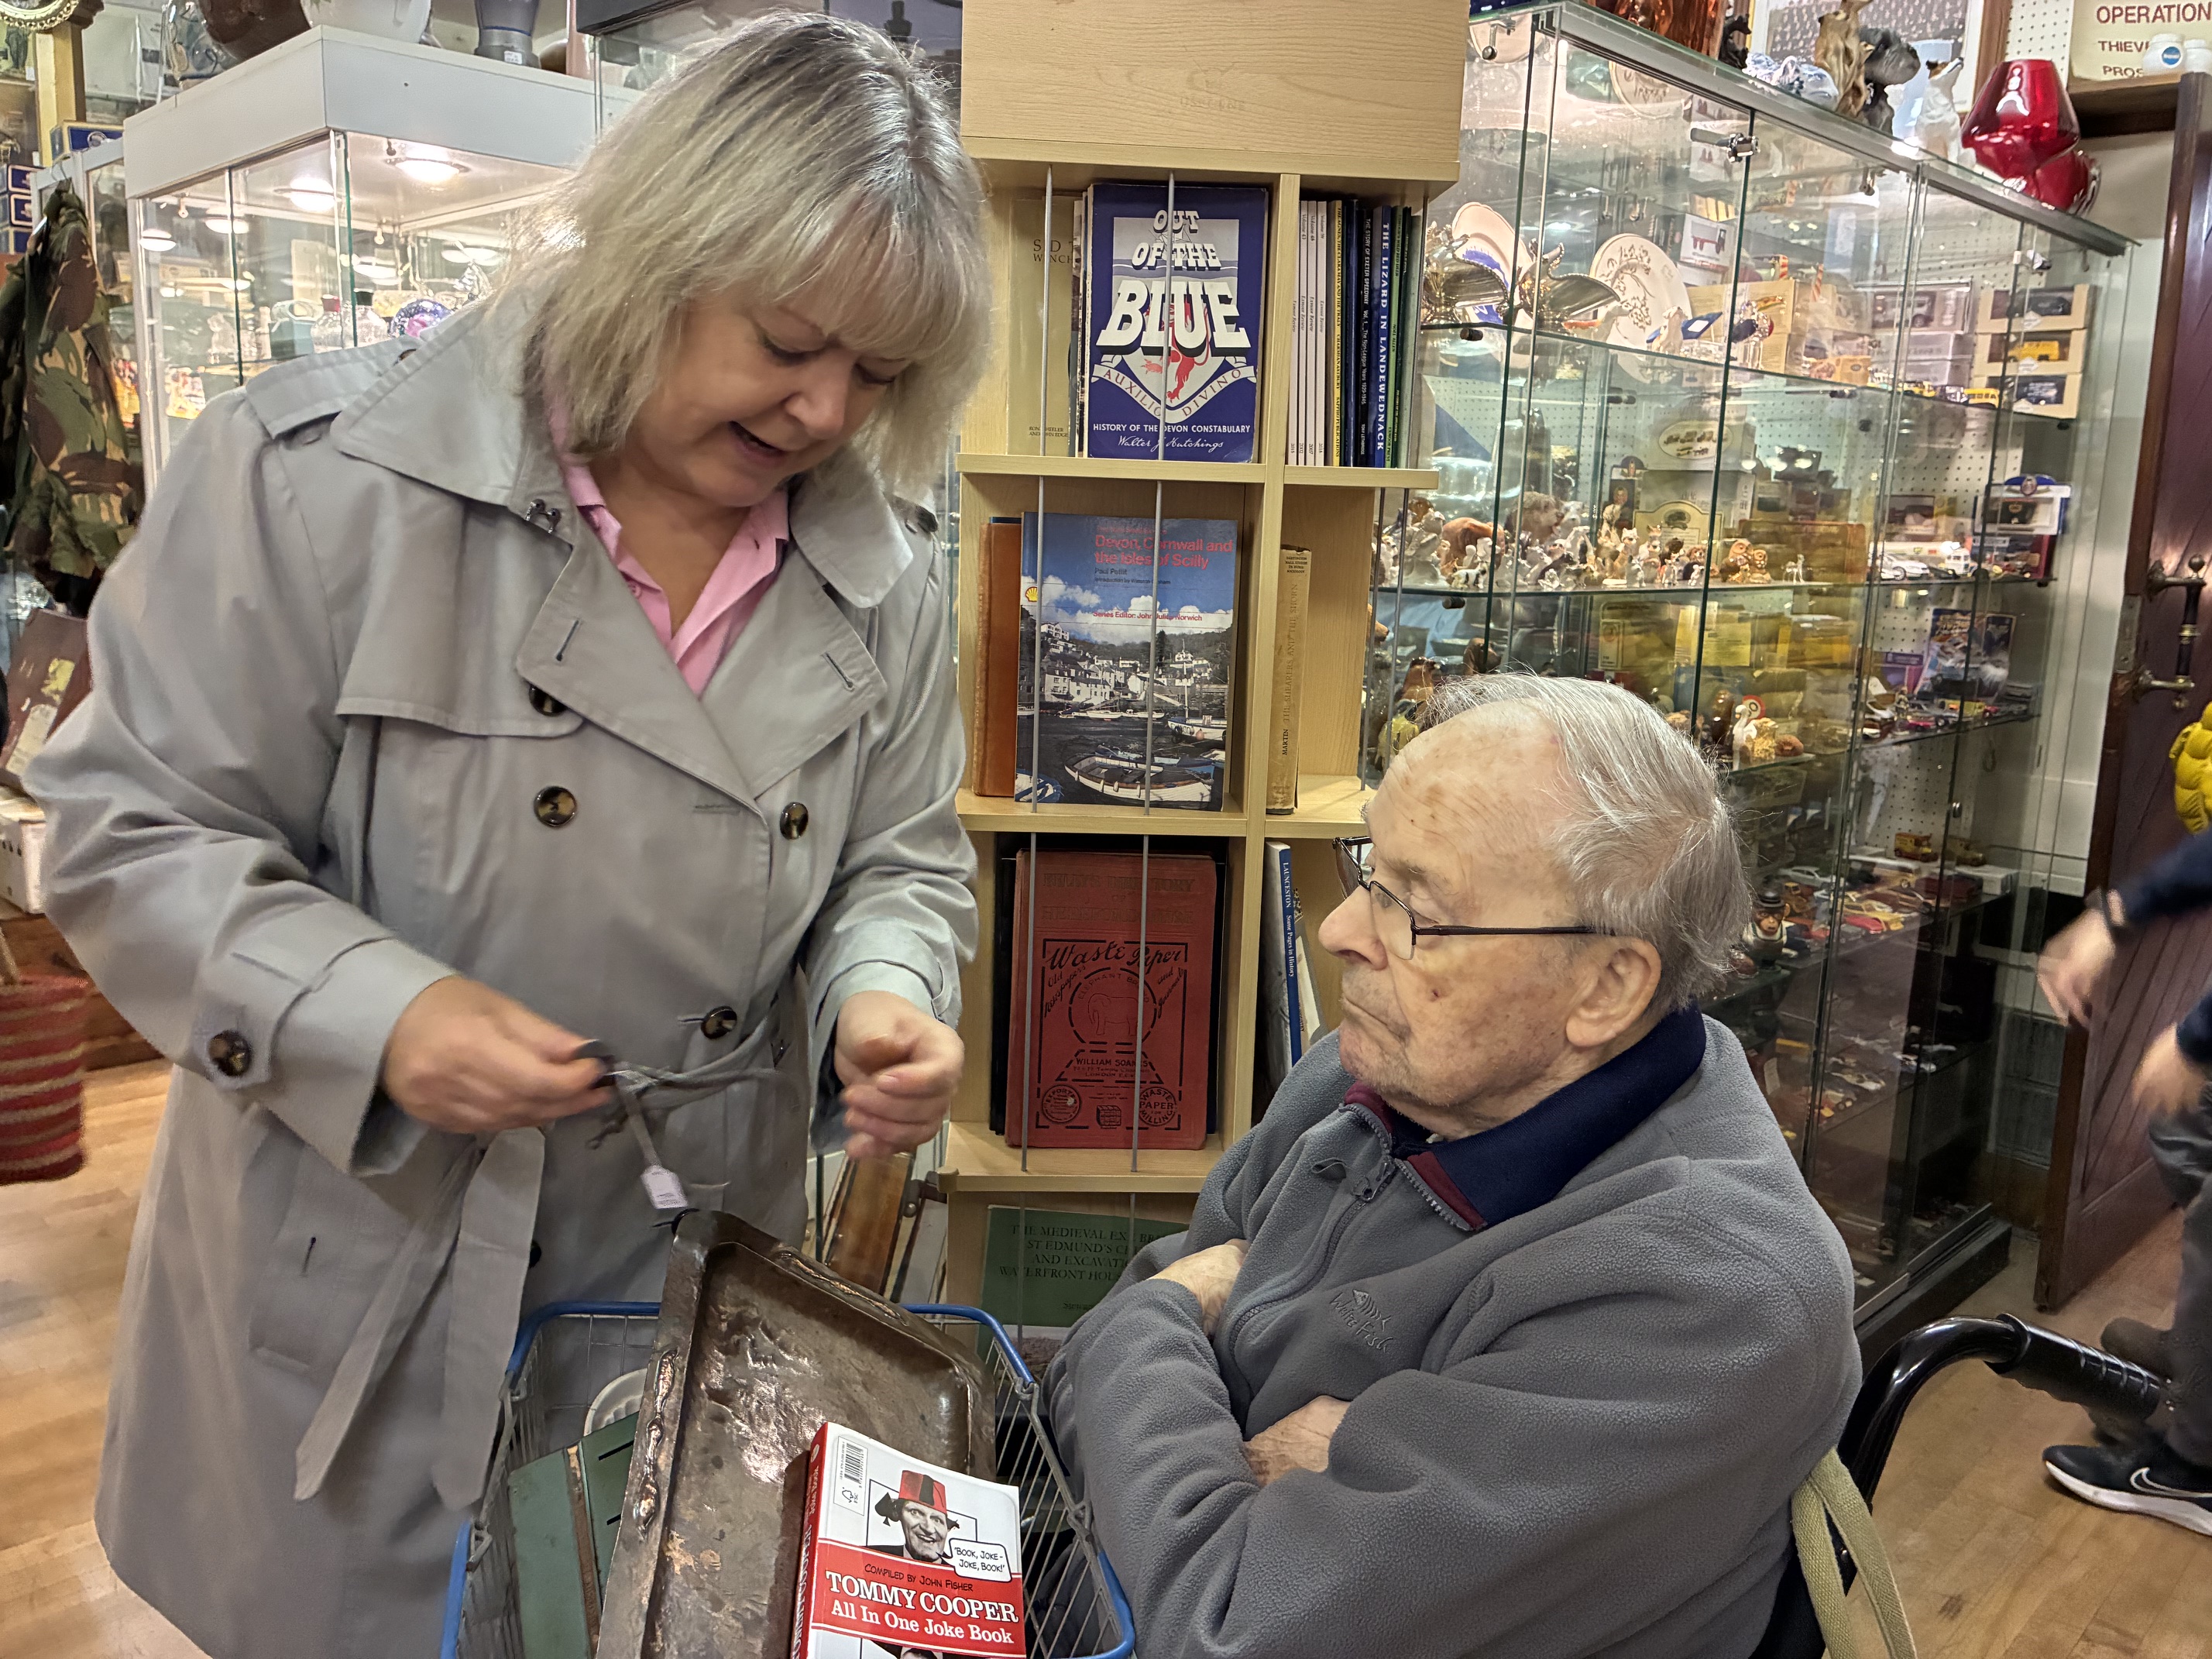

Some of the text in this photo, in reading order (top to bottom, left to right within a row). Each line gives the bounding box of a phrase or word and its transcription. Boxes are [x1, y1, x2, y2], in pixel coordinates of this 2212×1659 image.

[1152, 209, 1200, 233] OUT
[1132, 242, 1222, 271] OF THE
[1095, 280, 1252, 357] BLUE
[1380, 315, 1387, 329] IN
[1182, 369, 1242, 417] DIVINO
[1377, 336, 1387, 450] LANDEWEDNACK
[1093, 424, 1126, 432] HISTORY
[1191, 425, 1251, 434] CONSTABULARY
[1118, 435, 1152, 447] Walter
[1166, 437, 1224, 453] Hutchings
[1095, 534, 1233, 552] Devon, Crnwall and
[1094, 551, 1118, 565] the
[1120, 551, 1152, 566] Isles
[1172, 554, 1209, 570] Scilly
[1283, 659, 1293, 702] SHEARERS
[1290, 583, 1298, 613] SHORN
[1283, 862, 1291, 908] LAUNCESTON
[1046, 940, 1125, 970] Waste
[1048, 971, 1063, 988] Old
[1076, 1057, 1111, 1066] WILLIAM
[1142, 1089, 1173, 1101] WASTE
[1041, 1227, 1106, 1240] MEDIEVAL
[1028, 1241, 1042, 1249] ST
[1046, 1241, 1112, 1254] EDMUND'S
[1032, 1254, 1061, 1264] AND
[1000, 1266, 1086, 1279] WAERFRONT
[1329, 1292, 1393, 1353] Weird Fish
[959, 1559, 981, 1571] JOKE,
[864, 1564, 974, 1592] COMPILED BY JOHN FISHER
[825, 1570, 1020, 1623] TOMMY COOPER
[831, 1599, 1015, 1645] All In One Joke Book
